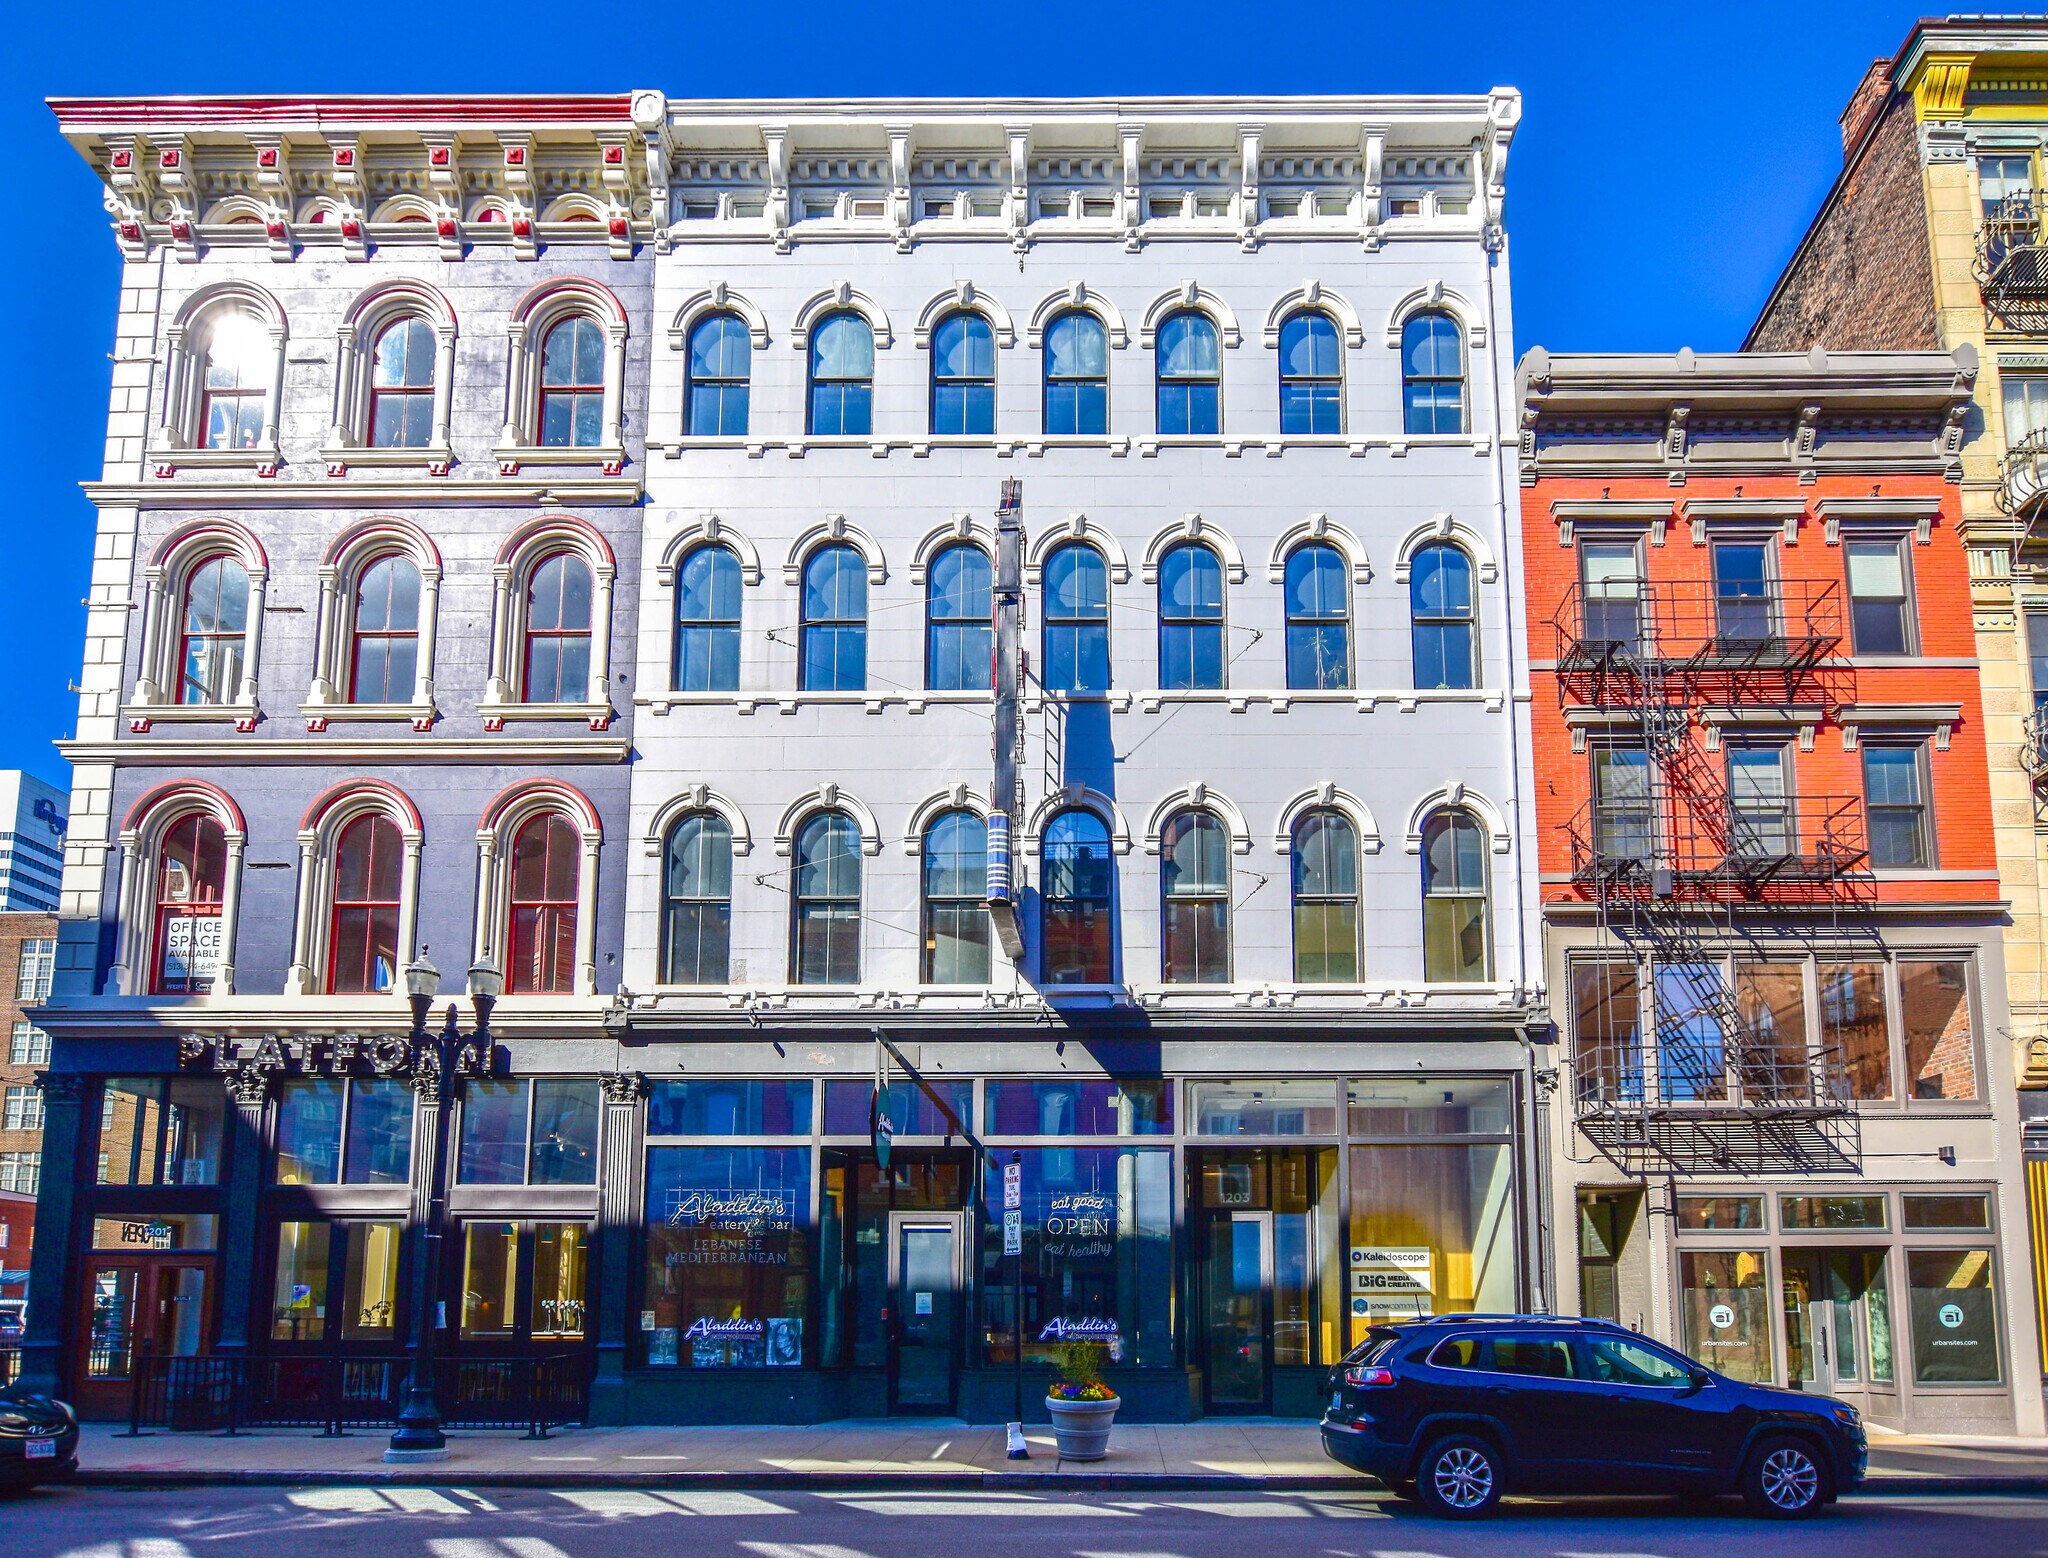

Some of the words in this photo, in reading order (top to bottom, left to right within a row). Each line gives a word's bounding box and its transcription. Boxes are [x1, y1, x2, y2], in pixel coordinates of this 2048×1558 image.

[170, 922, 222, 933] OFFICE
[169, 936, 221, 947] SPACE
[1009, 1167, 1016, 1175] NO
[1005, 1176, 1019, 1184] PARKING
[1051, 1196, 1070, 1210] eat
[1072, 1197, 1105, 1211] good
[1220, 1193, 1250, 1203] 1203
[671, 1192, 785, 1226] Aladdin's
[709, 1220, 750, 1232] eatery
[768, 1217, 790, 1230] bar
[1047, 1217, 1110, 1236] OPEN
[694, 1240, 762, 1251] LEBANESE
[1007, 1239, 1018, 1247] PARK
[1044, 1243, 1066, 1256] eat
[1068, 1241, 1113, 1257] healthy
[666, 1253, 786, 1263] MEDITERRANEAN
[684, 1316, 763, 1340] Aladdin's
[1040, 1317, 1118, 1340] Aladdin's
